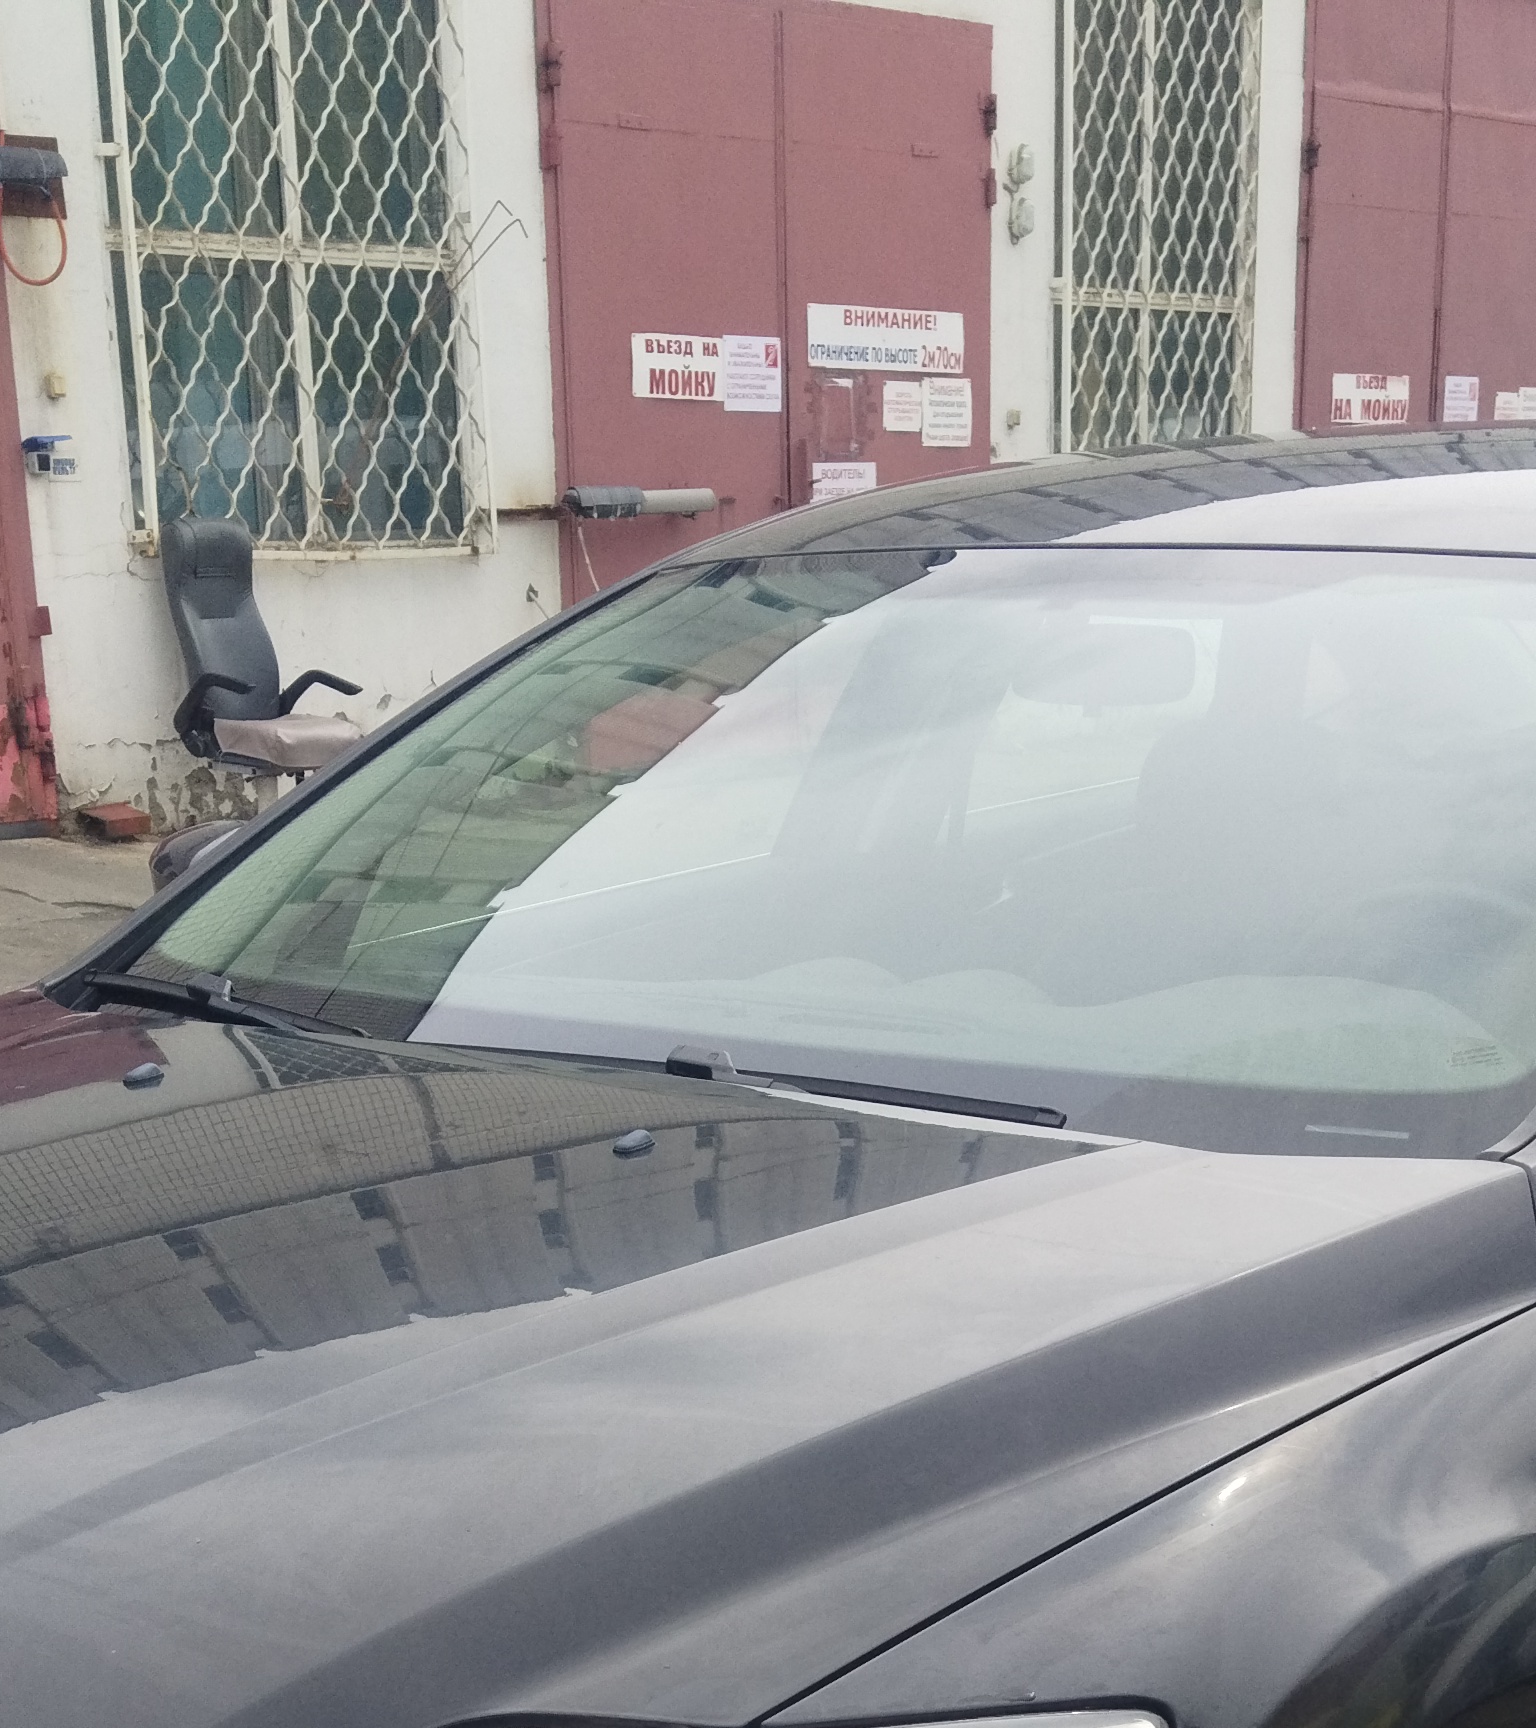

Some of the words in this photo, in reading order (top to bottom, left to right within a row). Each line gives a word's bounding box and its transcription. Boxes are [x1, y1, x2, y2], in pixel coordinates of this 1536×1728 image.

[843, 309, 937, 331] ВНИМАНИЕ!
[645, 339, 694, 358] ВЪЕЗД
[702, 342, 719, 358] НА
[810, 343, 869, 362] ОГРАНИЧЕНИЕ
[871, 347, 883, 363] ПО
[884, 348, 918, 364] ВЫСОТЕ
[649, 364, 716, 397] МОЙКУ
[1356, 375, 1388, 391] ВЪЕЗД
[1333, 399, 1352, 420] НА
[1360, 394, 1407, 421] МОЙКУ
